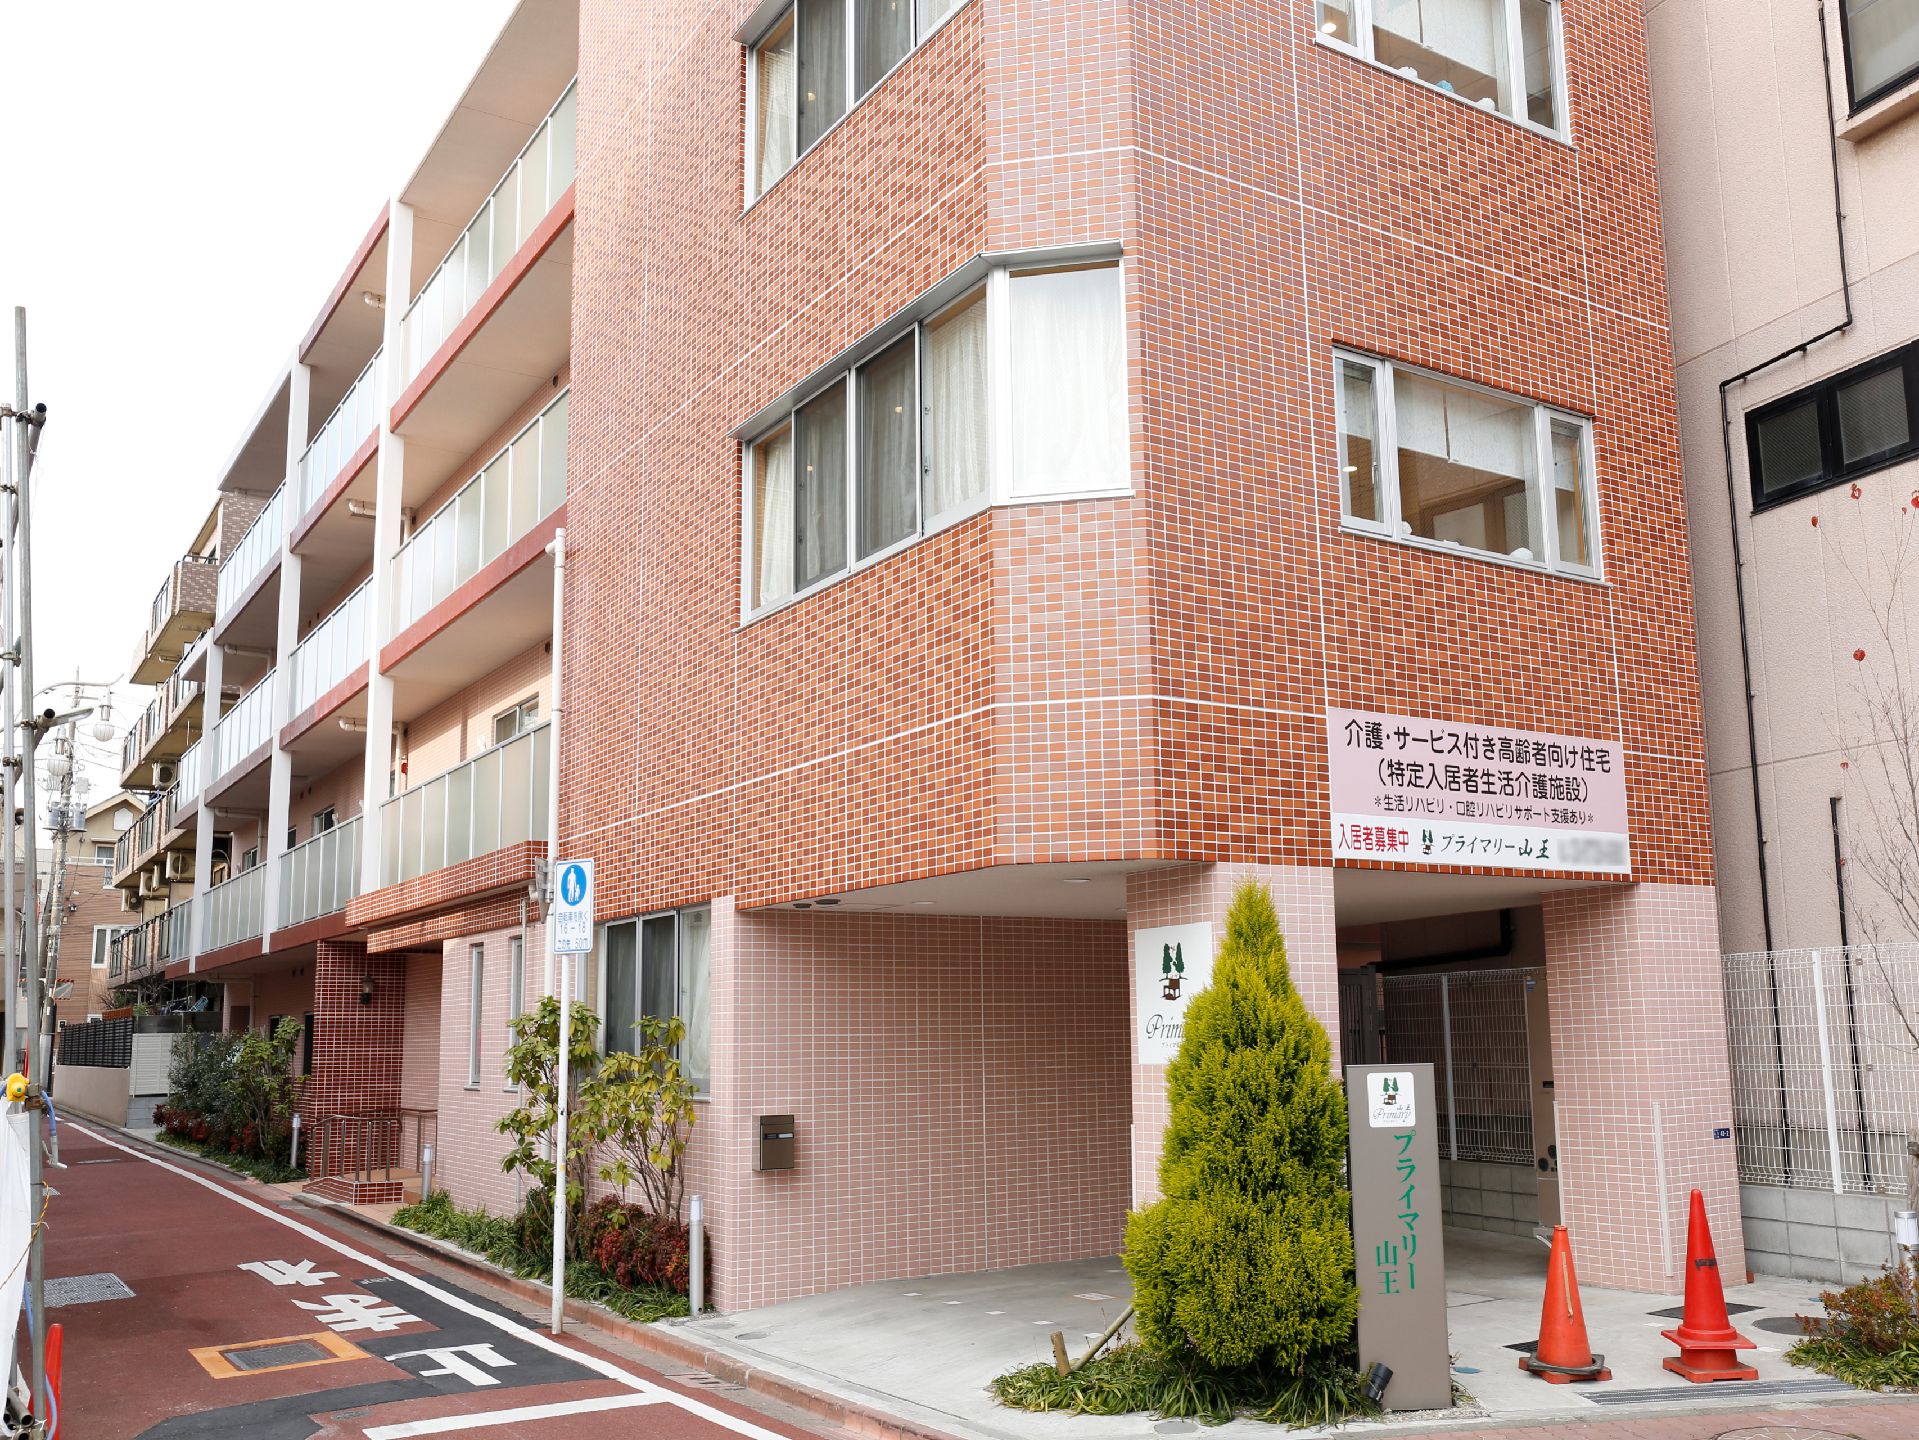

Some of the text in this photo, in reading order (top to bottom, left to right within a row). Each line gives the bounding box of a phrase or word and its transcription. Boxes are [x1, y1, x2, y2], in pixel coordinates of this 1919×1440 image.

[1344, 718, 1611, 773] 介護・サービス付き高齢者向け住宅
[1378, 757, 1588, 803] （特定入居者生活介護施設）
[1338, 823, 1410, 853] 入居者募集中
[1441, 833, 1550, 859] プライマリー山王
[1146, 1013, 1184, 1040] Prim
[1393, 1129, 1420, 1290] プライマリー
[1376, 1240, 1400, 1295] 山王
